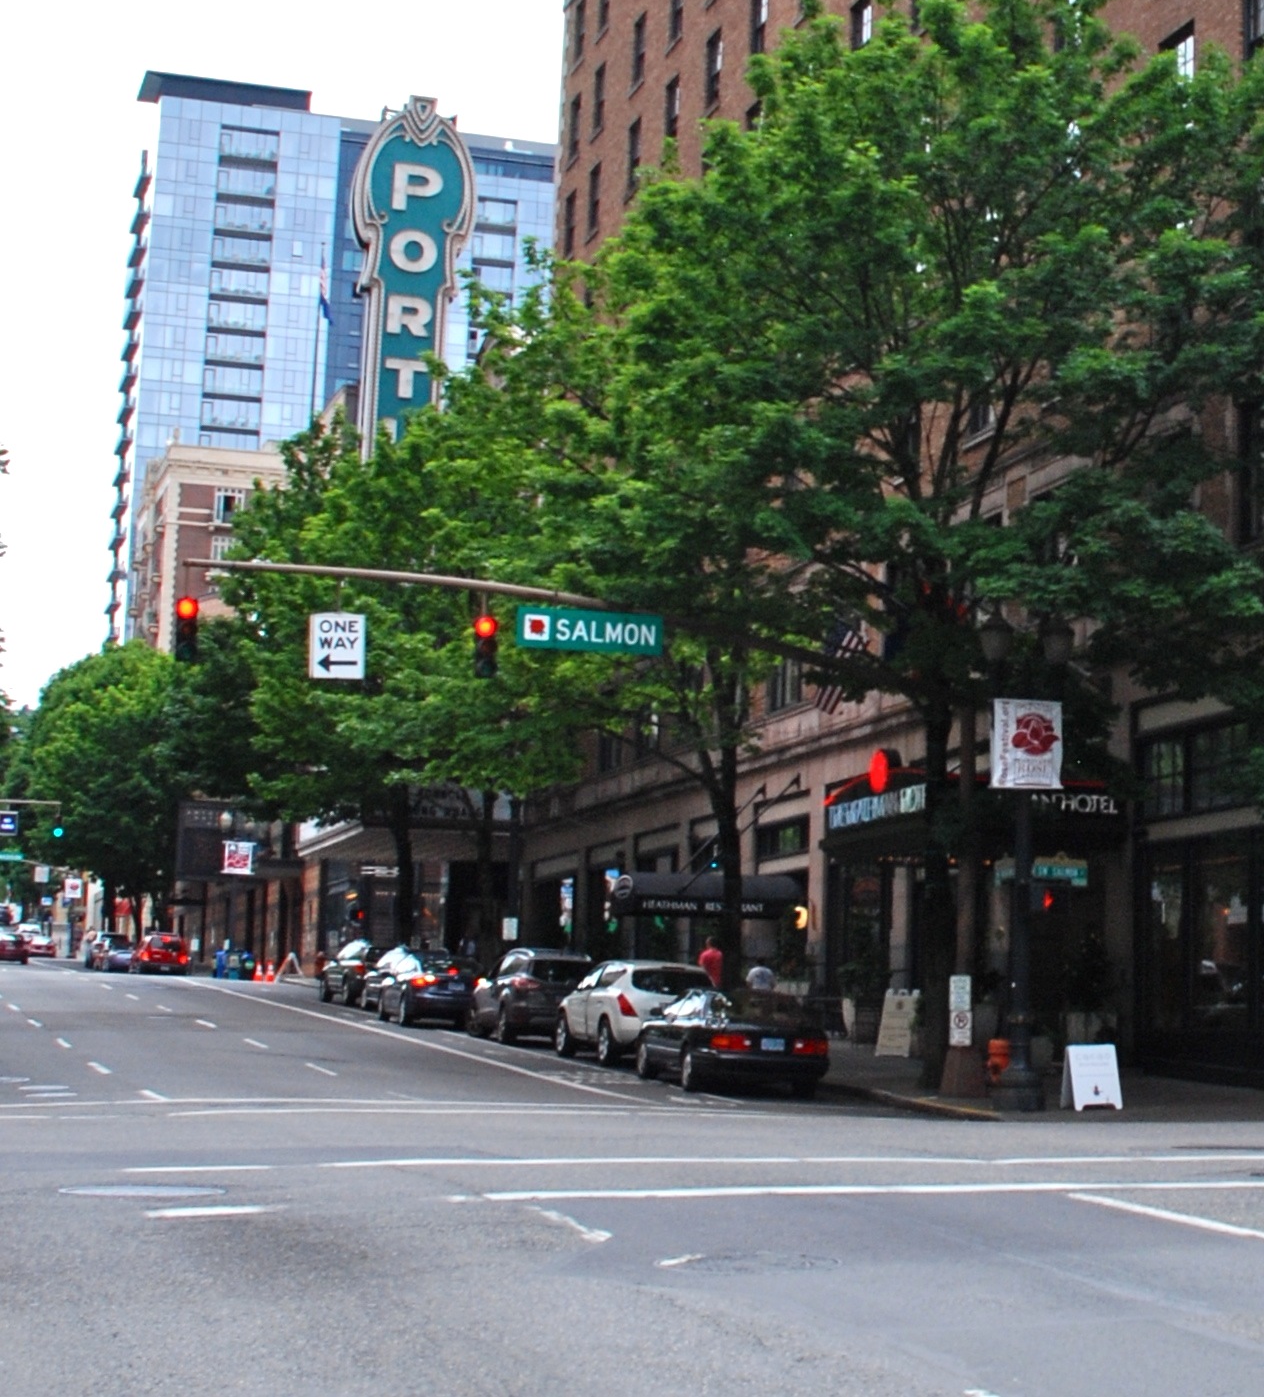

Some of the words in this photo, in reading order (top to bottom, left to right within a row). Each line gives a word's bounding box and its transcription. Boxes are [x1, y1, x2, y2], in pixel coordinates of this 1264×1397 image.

[319, 619, 358, 633] ONE
[555, 618, 657, 646] SALMON
[318, 636, 358, 650] WAY
